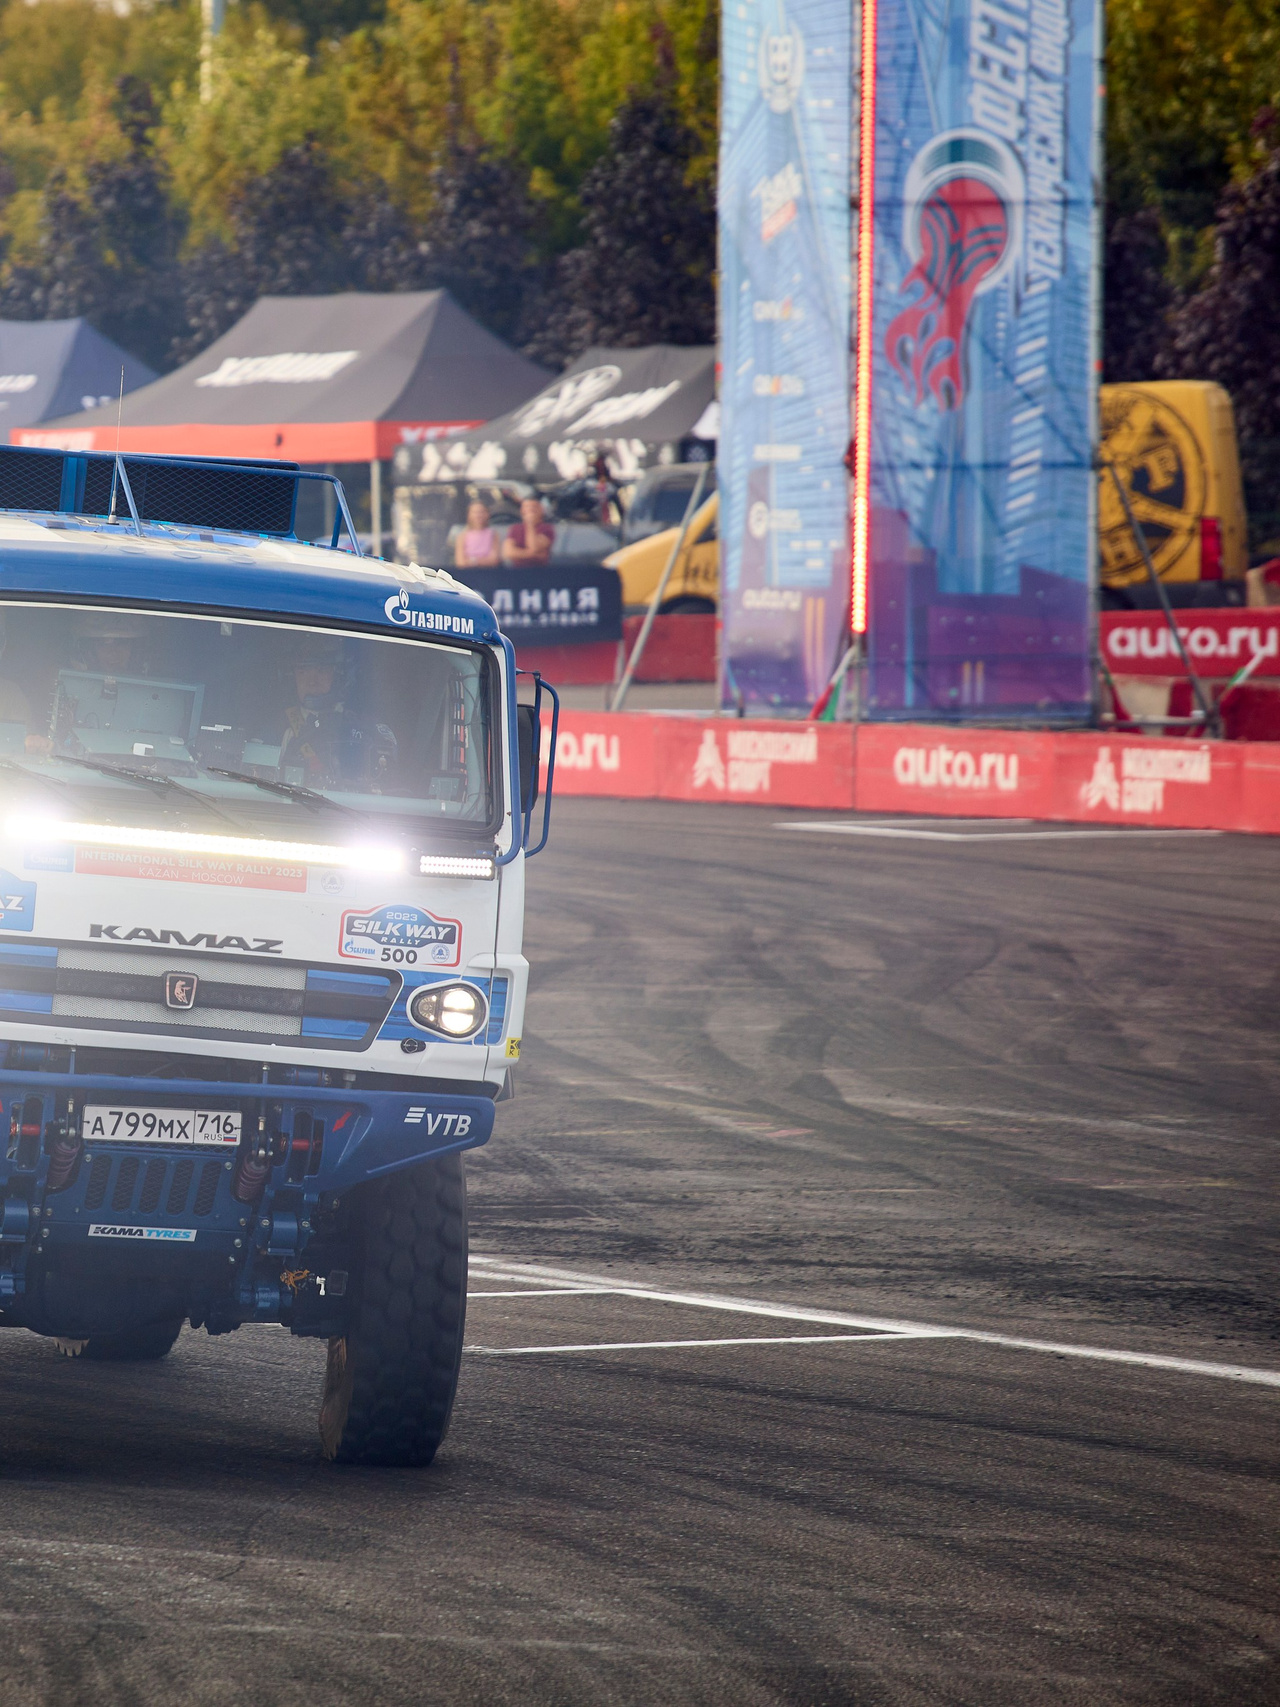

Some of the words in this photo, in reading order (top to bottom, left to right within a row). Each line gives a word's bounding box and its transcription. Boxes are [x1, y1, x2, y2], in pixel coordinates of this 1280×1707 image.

[476, 586, 599, 613] ЛНИЯ
[410, 610, 474, 635] ГАЗПРОМ
[893, 744, 1019, 791] auto.ru
[81, 850, 176, 867] INTERNATIONAL
[207, 860, 234, 873] WAY
[236, 863, 273, 876] RALLY
[275, 866, 303, 879] 2023
[138, 867, 179, 879] KAZAN
[191, 872, 245, 885] MOSCOW
[386, 911, 418, 921] 2023
[89, 923, 284, 954] KAMAZ
[351, 919, 403, 937] SILK
[405, 923, 452, 940] WAY
[381, 936, 421, 946] RALLY
[380, 947, 418, 964] 500
[197, 1113, 234, 1134] 716
[425, 1112, 472, 1137] VTB
[203, 1133, 223, 1142] RUS
[93, 1226, 144, 1237] KAMA
[145, 1228, 192, 1239] TYRES
